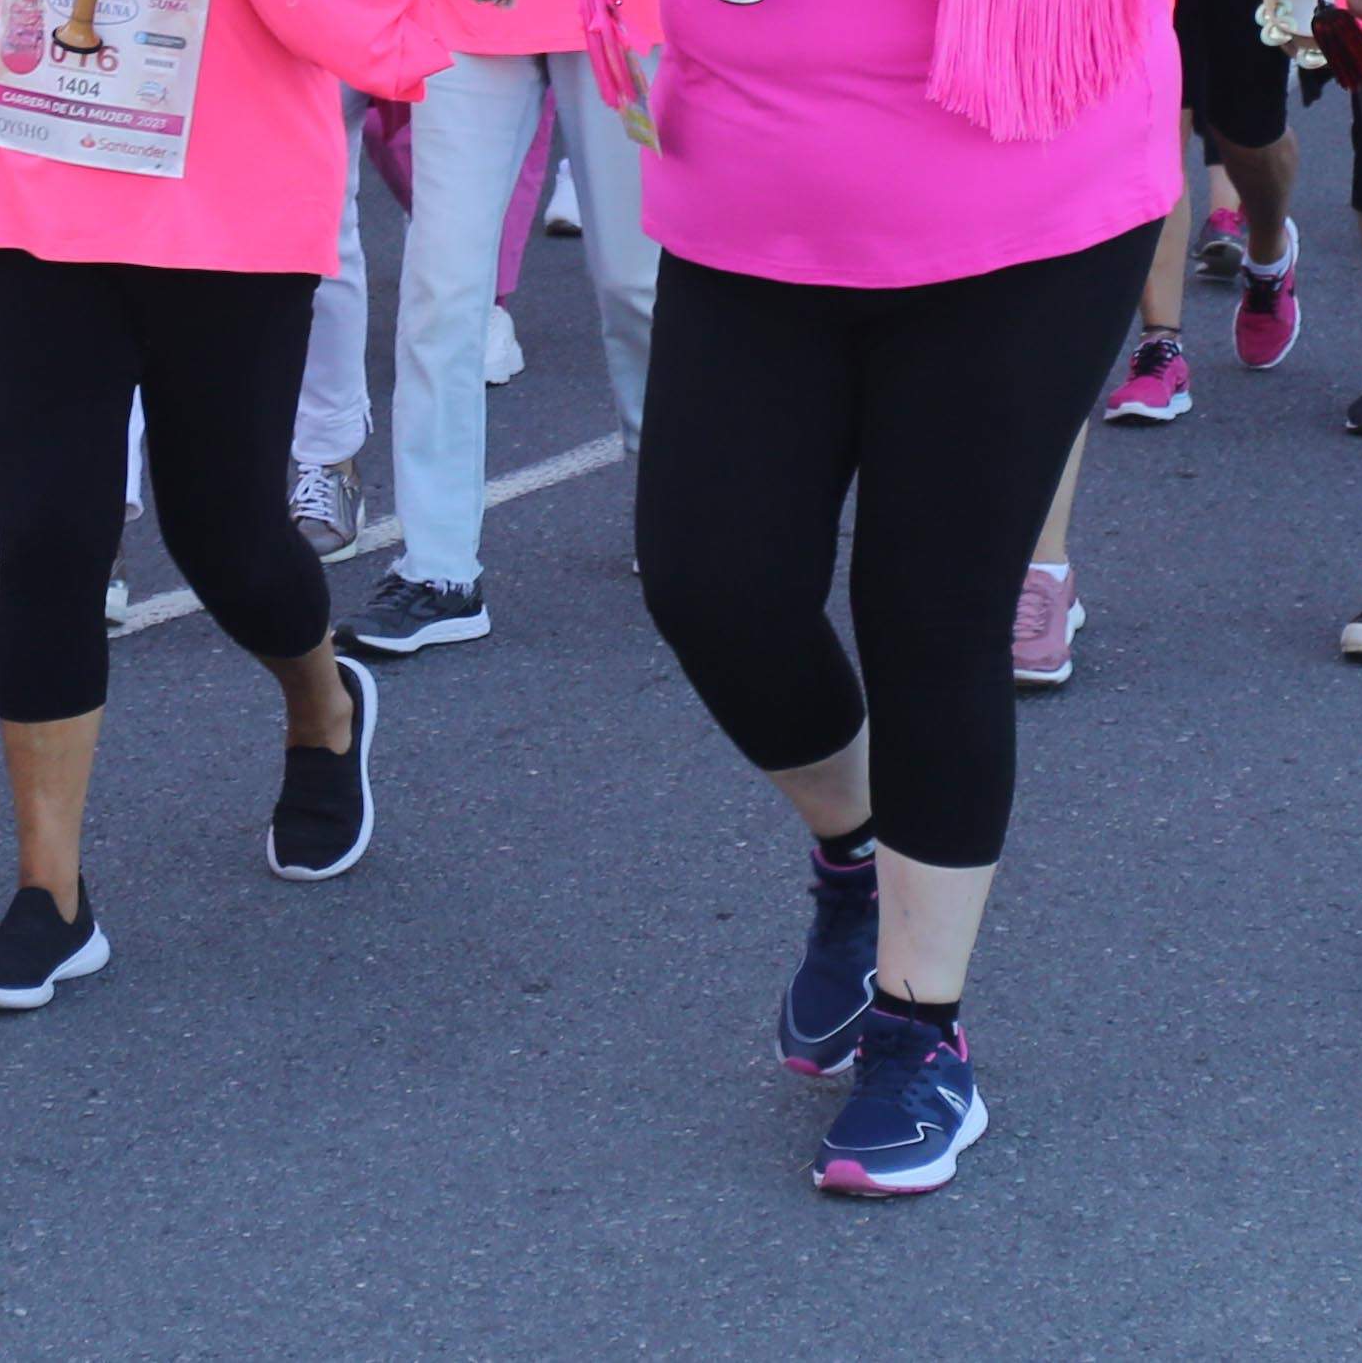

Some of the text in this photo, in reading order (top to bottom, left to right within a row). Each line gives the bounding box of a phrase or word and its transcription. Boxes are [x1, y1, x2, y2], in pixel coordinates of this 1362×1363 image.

[57, 74, 101, 98] 1404
[2, 91, 51, 111] CARRERA
[51, 100, 67, 114] DE
[68, 103, 86, 117] LA
[88, 108, 134, 125] MUJER
[97, 137, 168, 159] Santander
